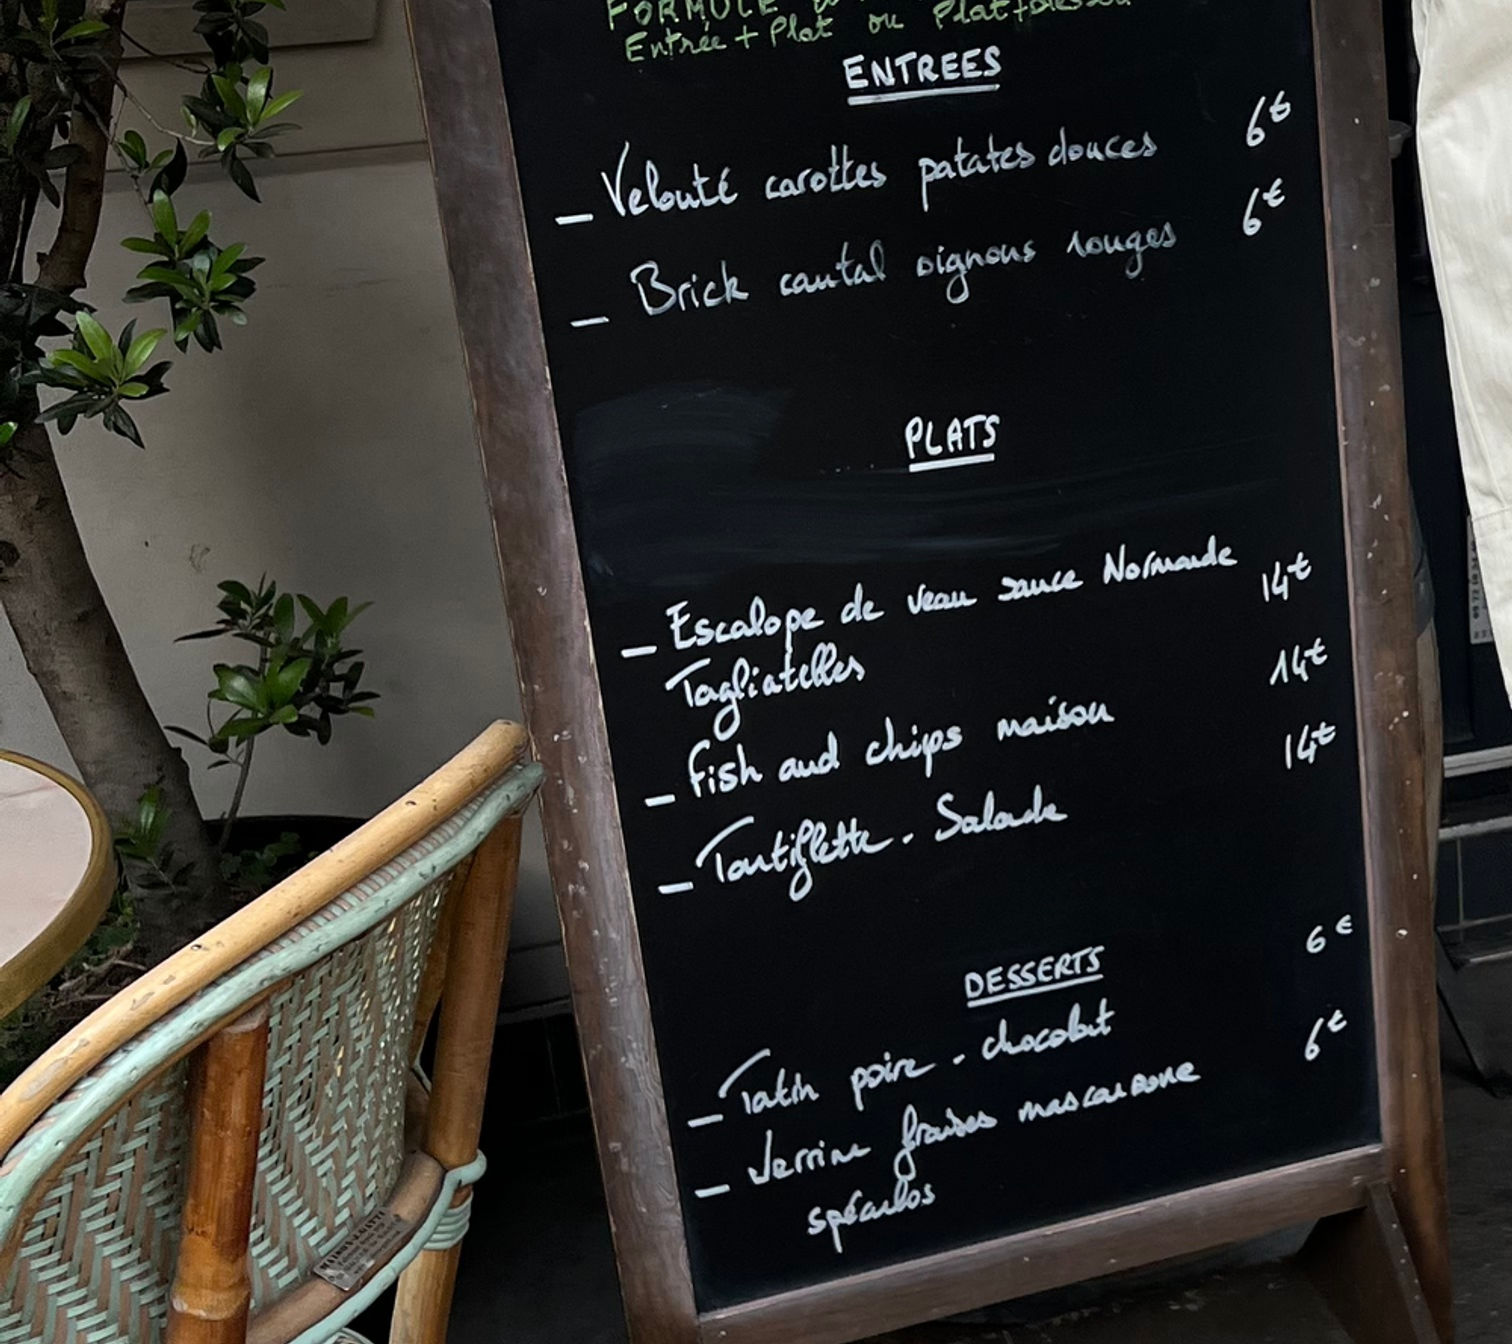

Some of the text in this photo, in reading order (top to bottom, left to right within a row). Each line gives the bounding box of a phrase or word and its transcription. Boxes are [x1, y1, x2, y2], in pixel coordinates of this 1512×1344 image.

[624, 30, 727, 63] Entrée
[769, 16, 834, 48] Plat
[868, 11, 905, 35] ou
[842, 45, 1002, 89] ENTREES
[600, 140, 739, 217] Velouté
[765, 144, 888, 200] carottes
[918, 131, 1036, 212] patates
[1047, 126, 1158, 167] douces
[629, 260, 750, 317] Brick
[915, 239, 1037, 304] oignons
[1066, 221, 1178, 279] rouges
[904, 413, 1001, 460] PLATS
[665, 595, 826, 653] Escalope
[841, 582, 885, 625] de
[997, 568, 1085, 602] sauce
[1103, 534, 1239, 585] Normande
[664, 641, 867, 742] Tagliatelles
[686, 738, 764, 799] Fish
[778, 730, 840, 783] and
[864, 715, 965, 778] chips
[996, 695, 1116, 742] maison
[695, 815, 894, 902] Tartiflette
[934, 783, 1069, 842] Salade
[963, 945, 1105, 1000] DESSERTS
[718, 1048, 820, 1115] Tatin
[850, 1050, 937, 1112] poire
[981, 997, 1116, 1061] chocolat
[893, 1103, 999, 1182] fraises
